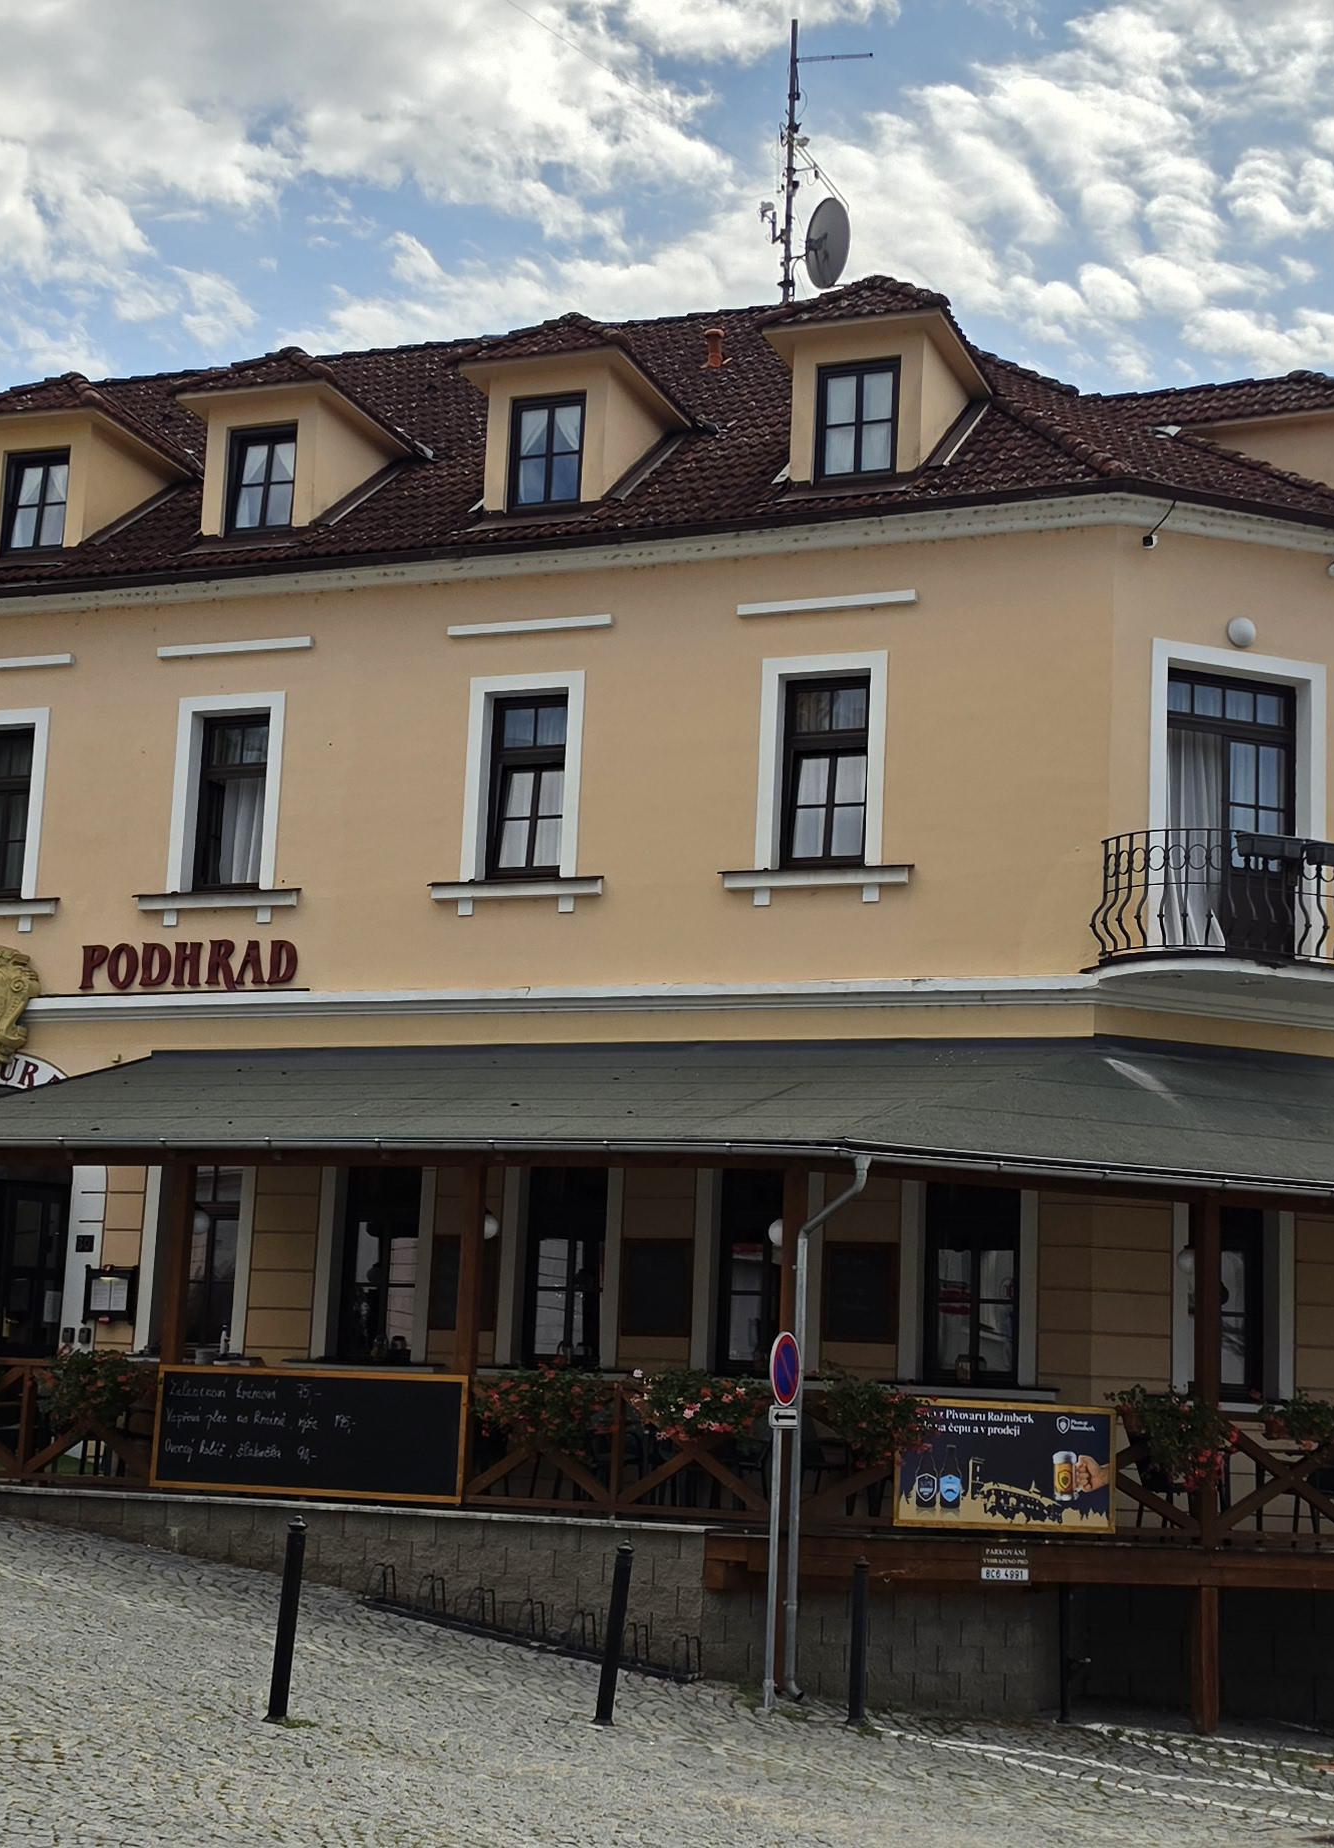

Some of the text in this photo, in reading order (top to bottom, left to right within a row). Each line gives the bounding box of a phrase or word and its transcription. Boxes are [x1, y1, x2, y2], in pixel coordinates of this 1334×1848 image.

[79, 938, 299, 991] PODHRAD
[945, 1409, 985, 1421] Pivovaru
[987, 1411, 1035, 1424] Rožmberk
[948, 1423, 971, 1436] čepu
[972, 1426, 979, 1434] a
[980, 1426, 985, 1434] v
[987, 1426, 1021, 1438] prodeji
